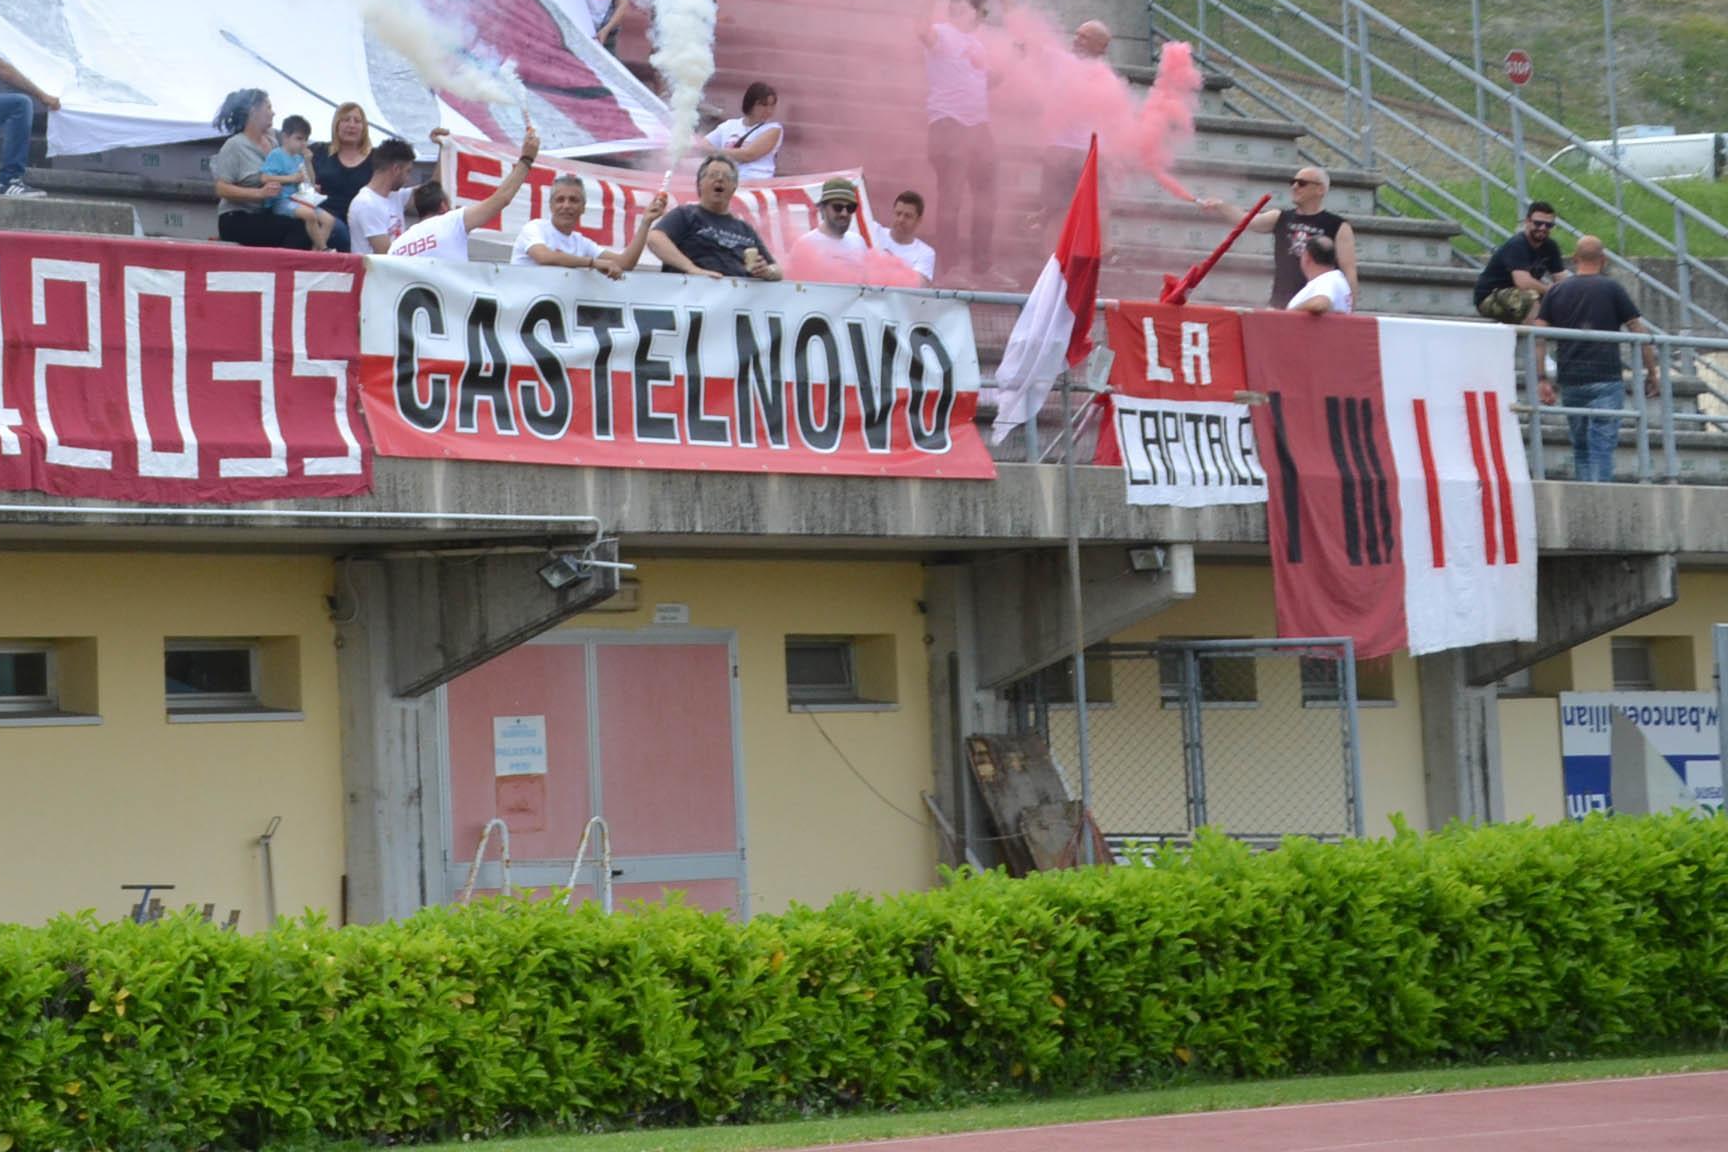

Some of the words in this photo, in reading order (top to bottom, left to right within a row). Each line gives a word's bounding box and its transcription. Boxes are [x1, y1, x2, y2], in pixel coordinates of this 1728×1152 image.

[393, 283, 954, 456] CASTELNOVO
[1142, 317, 1212, 385] LA
[1118, 407, 1264, 486] CAPITALE
